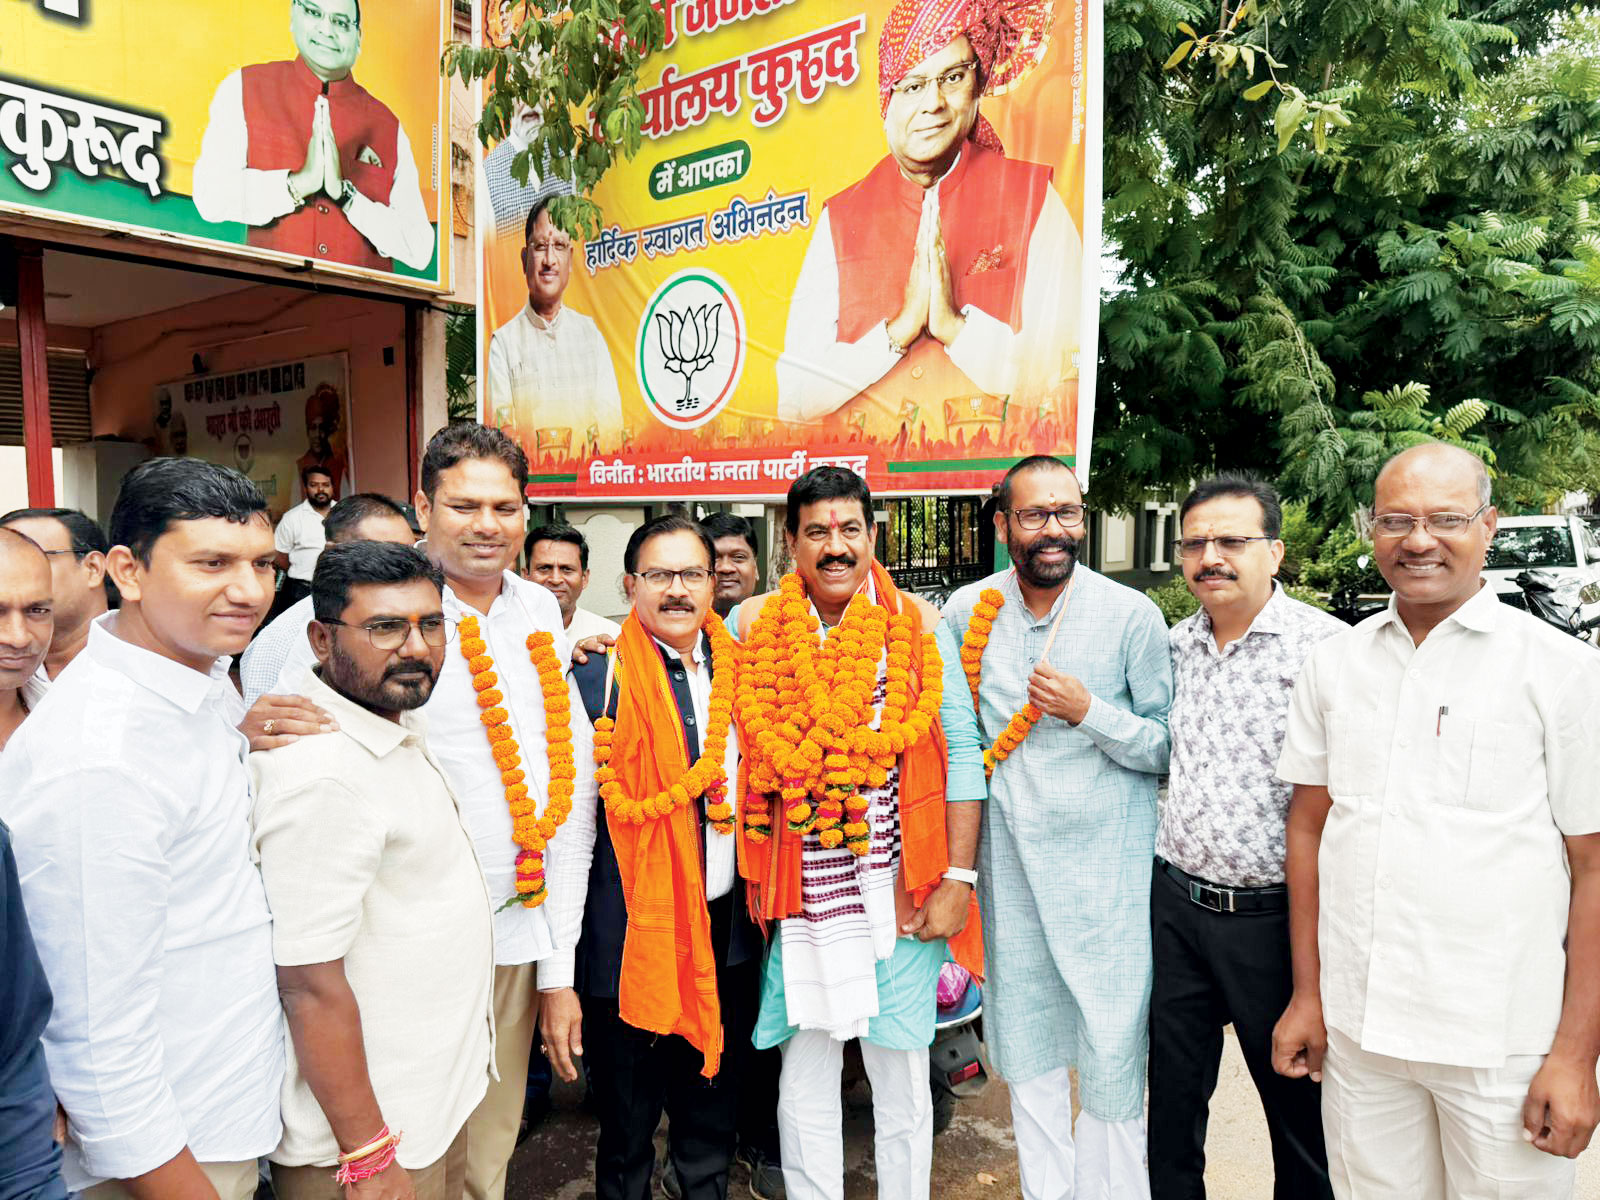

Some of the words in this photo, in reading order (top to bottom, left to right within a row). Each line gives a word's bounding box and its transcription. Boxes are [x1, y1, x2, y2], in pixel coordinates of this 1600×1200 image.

[588, 59, 742, 143] र्यालय
[655, 160, 677, 194] में
[677, 149, 744, 188] आपका
[585, 227, 637, 271] हार्दिक
[643, 216, 706, 254] स्वागत
[711, 194, 808, 240] अभिनंदन
[646, 455, 707, 483] भारतीय
[709, 459, 760, 481] जनता
[763, 450, 808, 480] पार्टी
